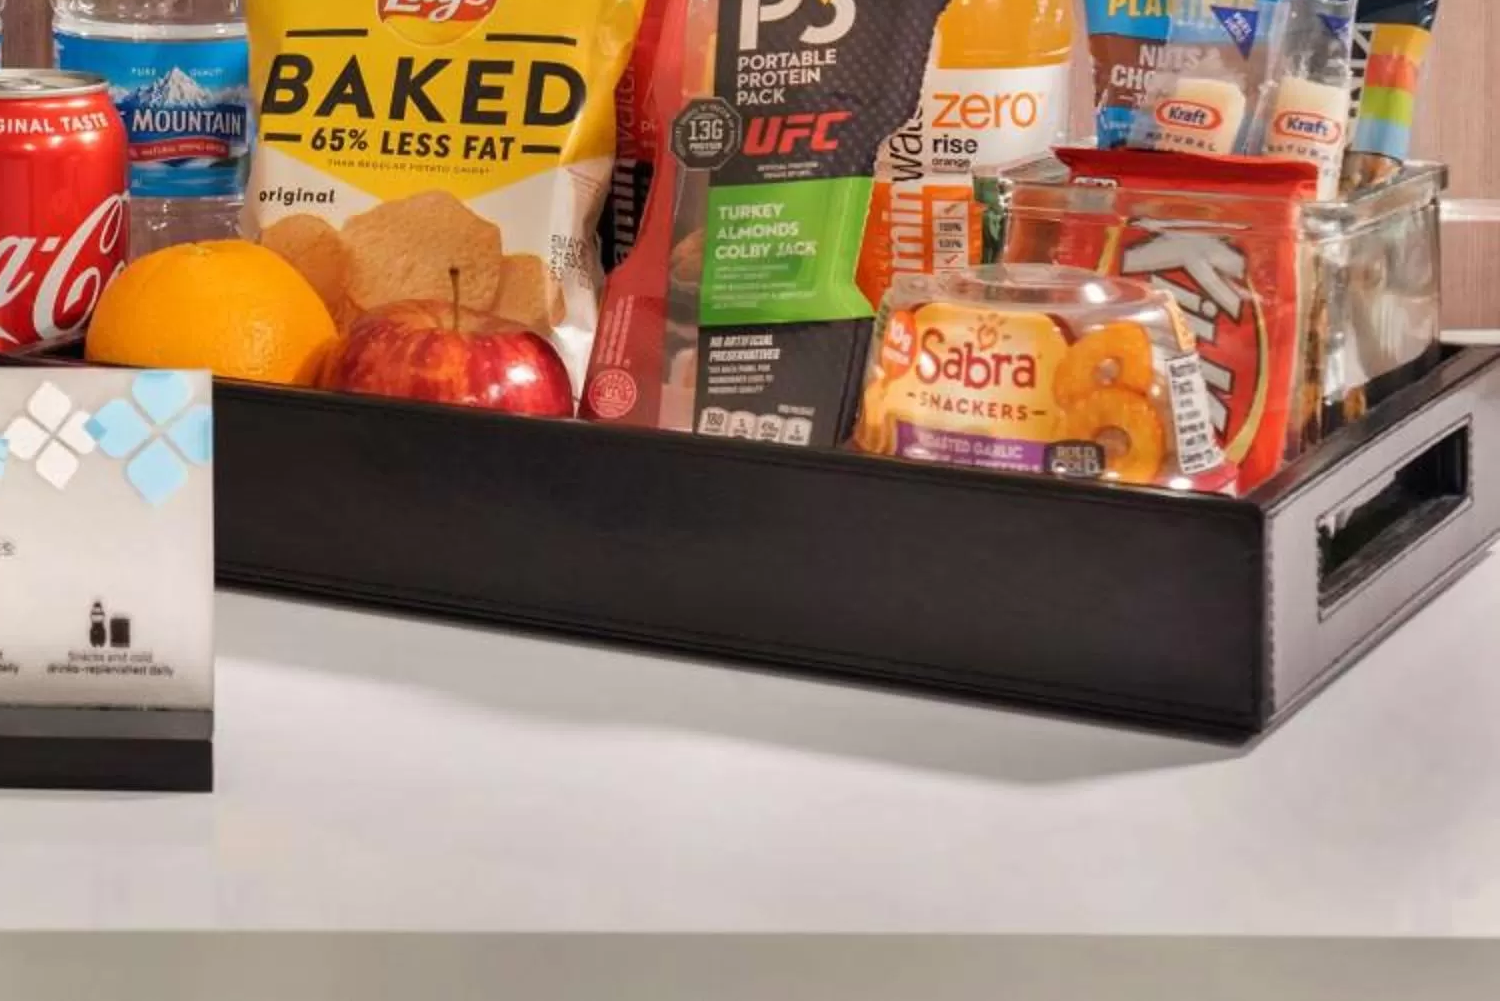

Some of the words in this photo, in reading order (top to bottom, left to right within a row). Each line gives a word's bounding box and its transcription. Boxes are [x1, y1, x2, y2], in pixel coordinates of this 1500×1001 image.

[736, 49, 838, 73] PORTABLE
[736, 67, 822, 89] PROTEIN
[260, 53, 589, 128] BAKED
[736, 88, 787, 107] PACK
[60, 111, 110, 132] TASTE
[931, 92, 1037, 130] zero
[1167, 106, 1207, 126] Kraft
[131, 109, 242, 136] MOUNTAIN
[687, 118, 725, 142] 13G
[743, 110, 854, 156] UFC
[1285, 116, 1329, 138] Kraft
[311, 127, 369, 153] 65%
[380, 130, 452, 157] LESS
[463, 135, 517, 162] FAT
[931, 134, 978, 155] rise
[931, 160, 971, 175] orange
[258, 185, 336, 208] original
[716, 202, 786, 221] TURKEY
[715, 220, 801, 240] ALMONDS
[713, 242, 773, 260] COLBY
[775, 239, 819, 258] JACK
[915, 326, 1036, 390] Sabra
[918, 390, 1029, 422] SNACKERS
